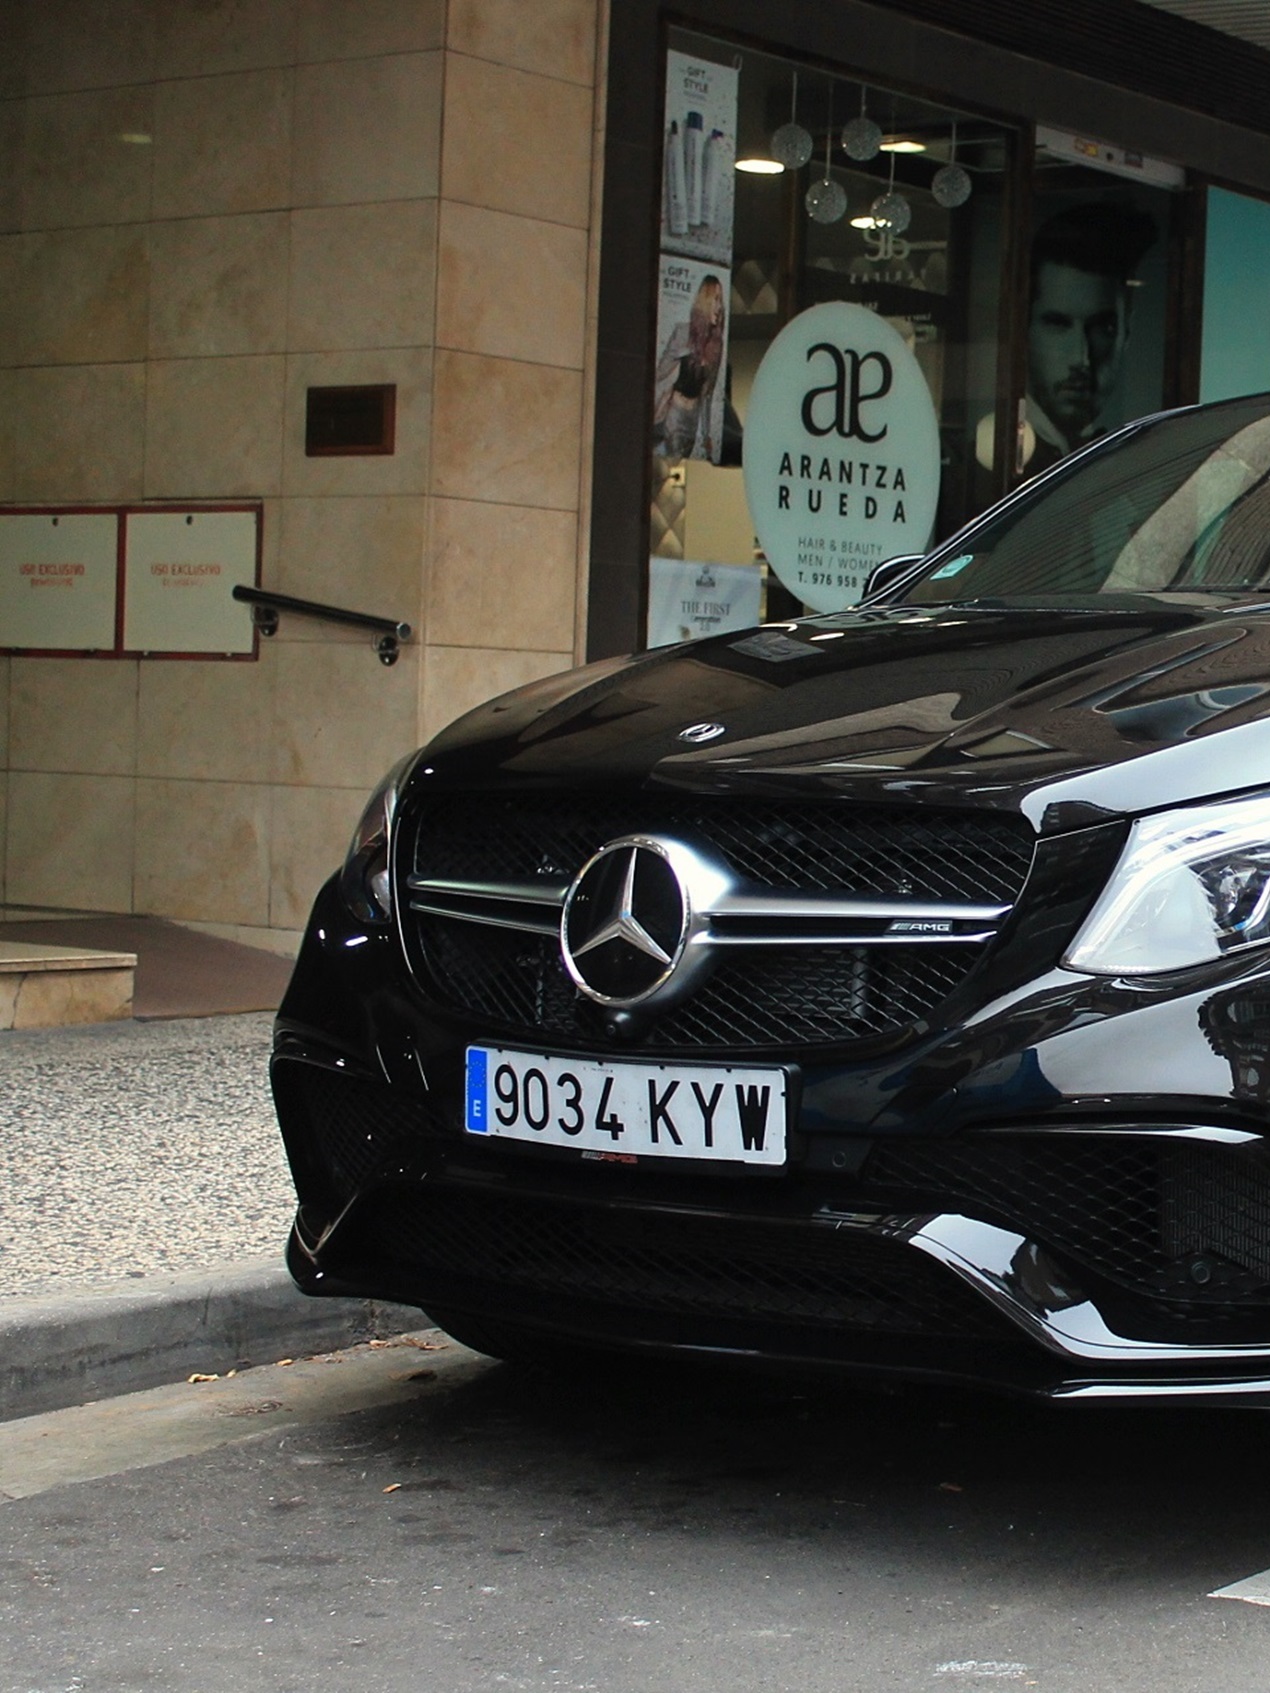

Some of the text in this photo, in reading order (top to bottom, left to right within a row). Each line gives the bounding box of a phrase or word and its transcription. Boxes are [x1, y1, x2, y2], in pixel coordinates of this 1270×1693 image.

[684, 78, 708, 94] STYLE
[667, 265, 690, 279] GIFT
[663, 278, 691, 293] STYLE
[779, 452, 906, 491] ARANTZA
[778, 485, 906, 523] RUEDA
[798, 537, 883, 555] HAIR & BEAUTY
[798, 554, 822, 567] MEN
[38, 563, 85, 576] EXCLUSIVO
[171, 563, 221, 576] EXCLUSIVO
[798, 571, 807, 583] T.
[812, 572, 832, 585] 976
[837, 575, 857, 588] 958
[681, 601, 731, 616] THE FIRST
[908, 923, 950, 931] AMG
[473, 1099, 481, 1117] E
[494, 1063, 771, 1151] 9034 KYW
